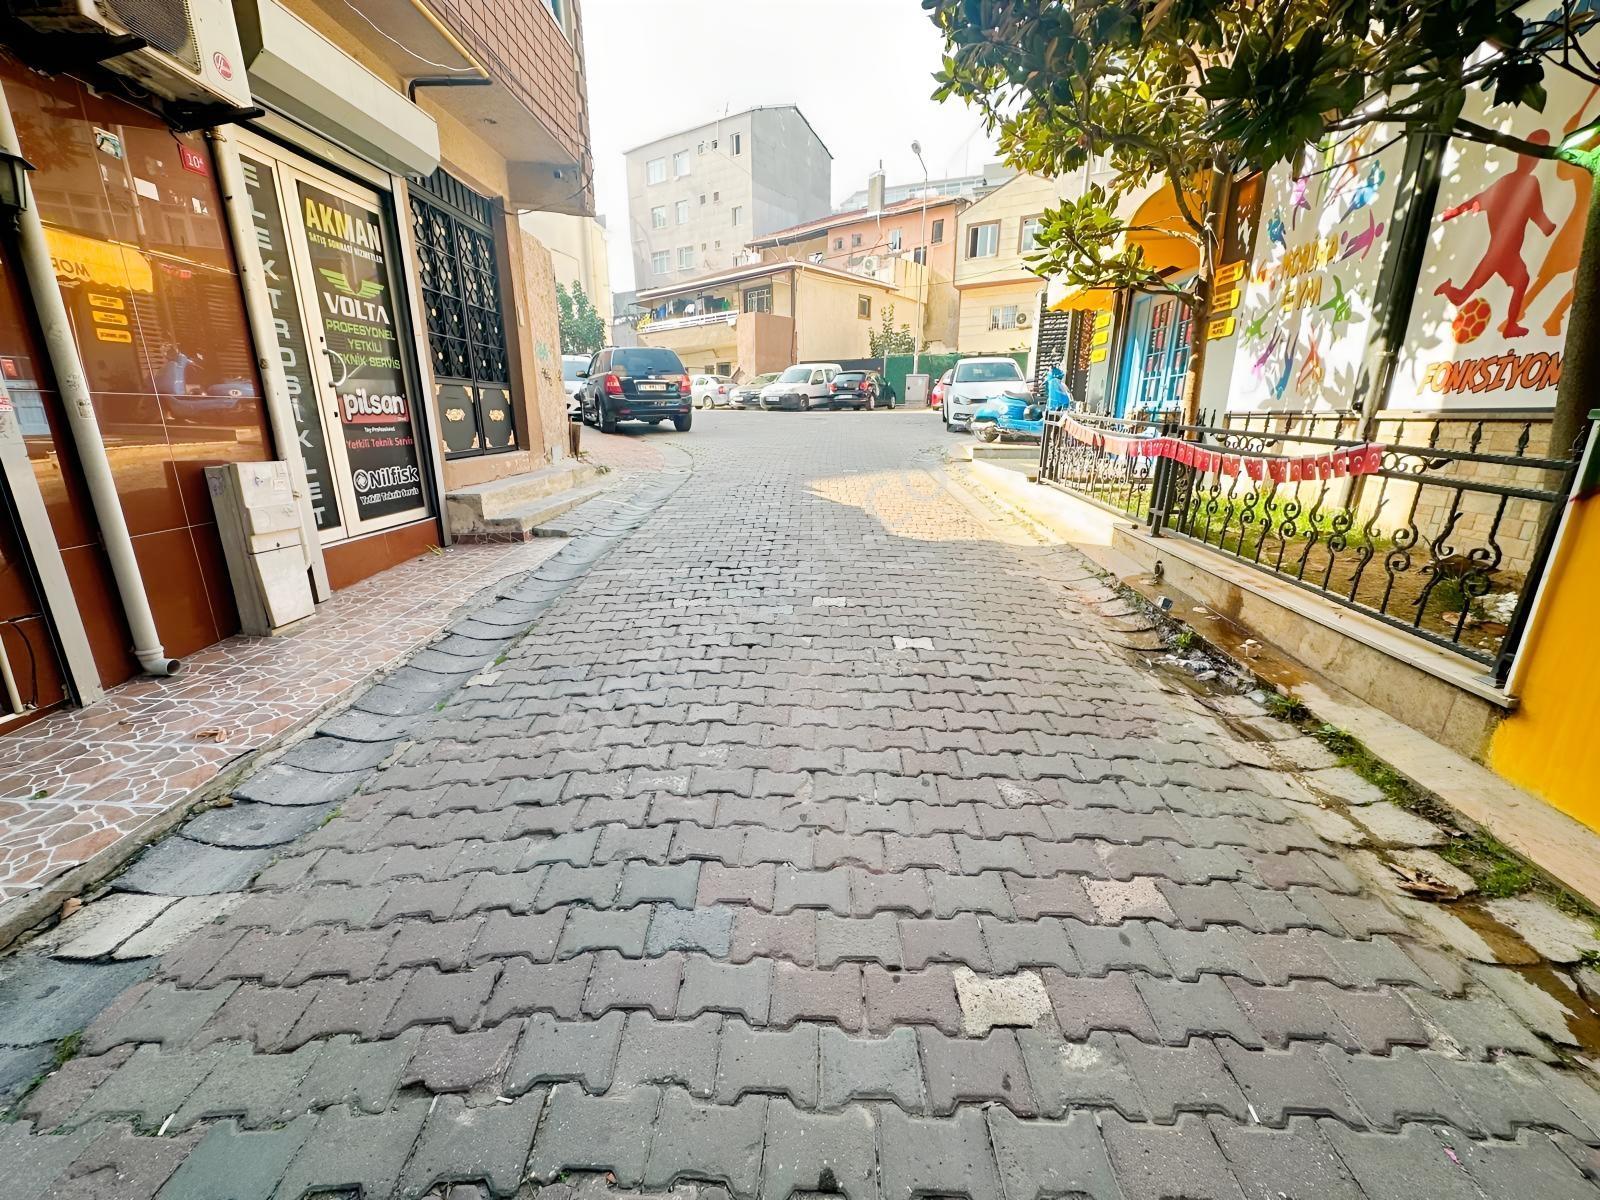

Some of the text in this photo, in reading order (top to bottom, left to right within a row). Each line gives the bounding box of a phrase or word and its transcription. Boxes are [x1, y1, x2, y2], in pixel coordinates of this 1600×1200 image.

[305, 197, 382, 253] AKMAN
[323, 291, 390, 325] VOLTA
[325, 318, 396, 341] PROFESYONEL
[369, 356, 401, 370] SERVİS
[342, 387, 405, 421] pilsan
[368, 465, 419, 490] Nilfisk
